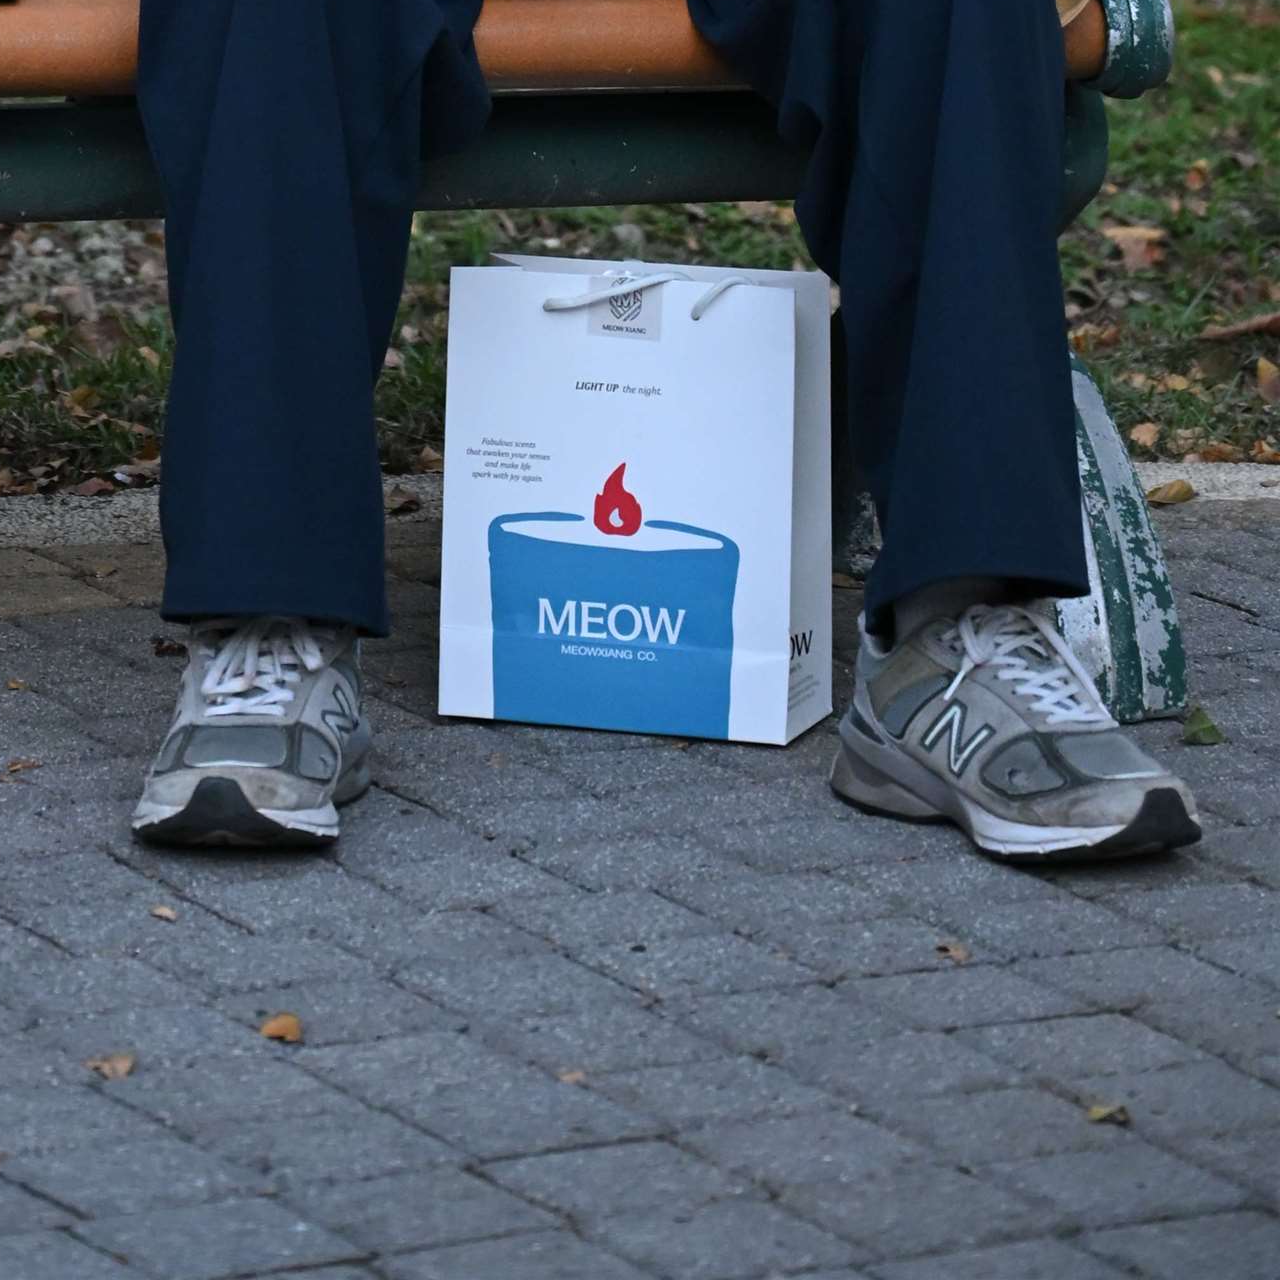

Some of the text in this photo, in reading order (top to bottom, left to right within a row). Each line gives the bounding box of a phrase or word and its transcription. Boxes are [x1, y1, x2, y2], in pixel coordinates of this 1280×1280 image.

[575, 380, 605, 391] LIGHT
[606, 383, 620, 392] UP
[622, 384, 637, 394] the
[465, 448, 481, 456] that
[492, 472, 509, 480] with
[538, 598, 687, 645] MEOW
[560, 644, 658, 662] MEOWXIANG CO.
[923, 698, 996, 778] N
